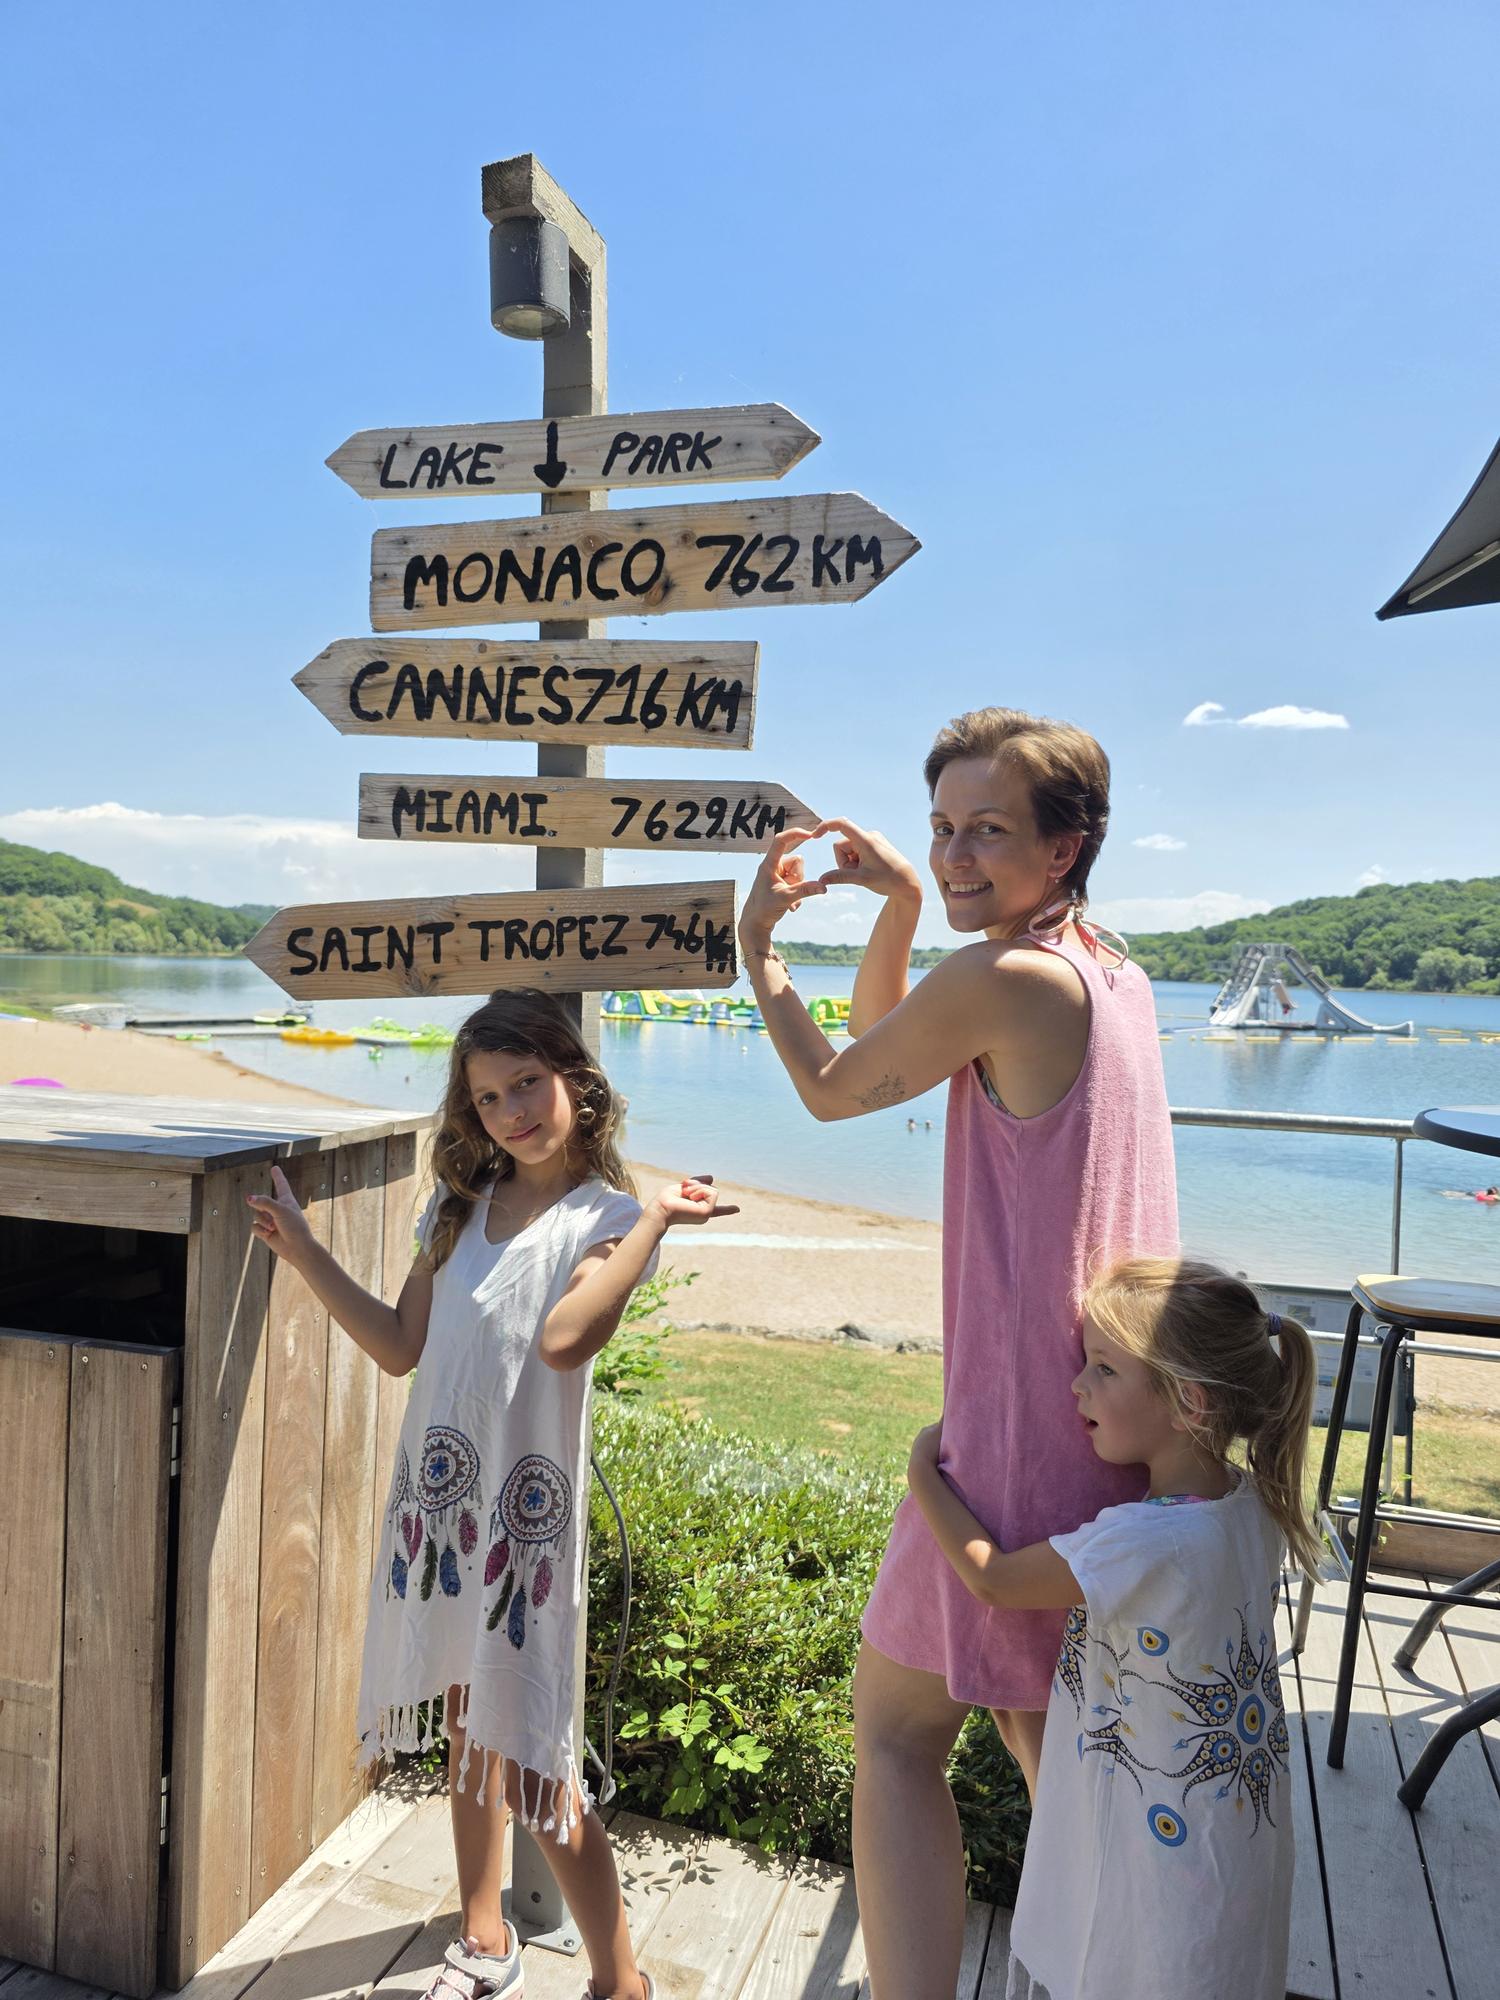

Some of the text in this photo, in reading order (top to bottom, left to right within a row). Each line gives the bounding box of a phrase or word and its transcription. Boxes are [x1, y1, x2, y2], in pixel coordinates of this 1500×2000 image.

[380, 430, 723, 489] LAKE PARK
[403, 532, 886, 611] MONACO 762 KM
[674, 671, 743, 733] KM
[286, 921, 455, 978] SAINT
[467, 913, 630, 962] TROPEZ
